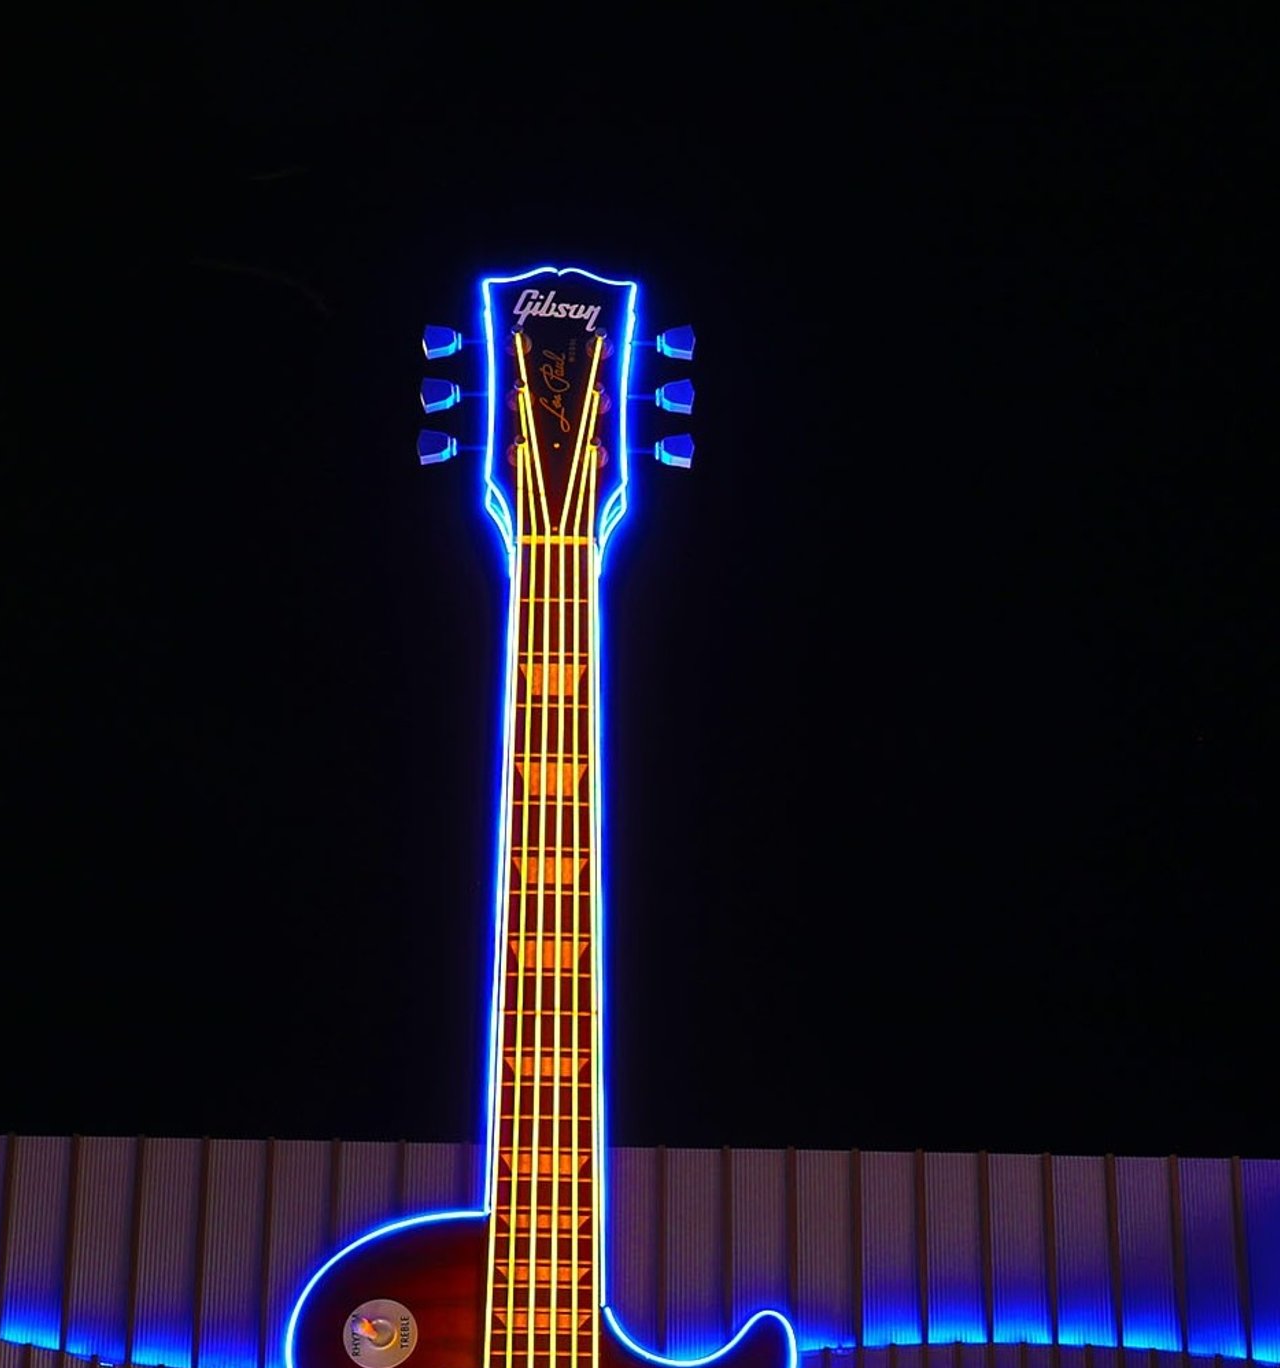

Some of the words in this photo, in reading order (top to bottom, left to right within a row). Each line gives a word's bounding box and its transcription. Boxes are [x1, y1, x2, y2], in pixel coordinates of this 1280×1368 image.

[513, 289, 601, 332] Gibson
[540, 349, 570, 392] Paul
[400, 1316, 410, 1349] TREBLE
